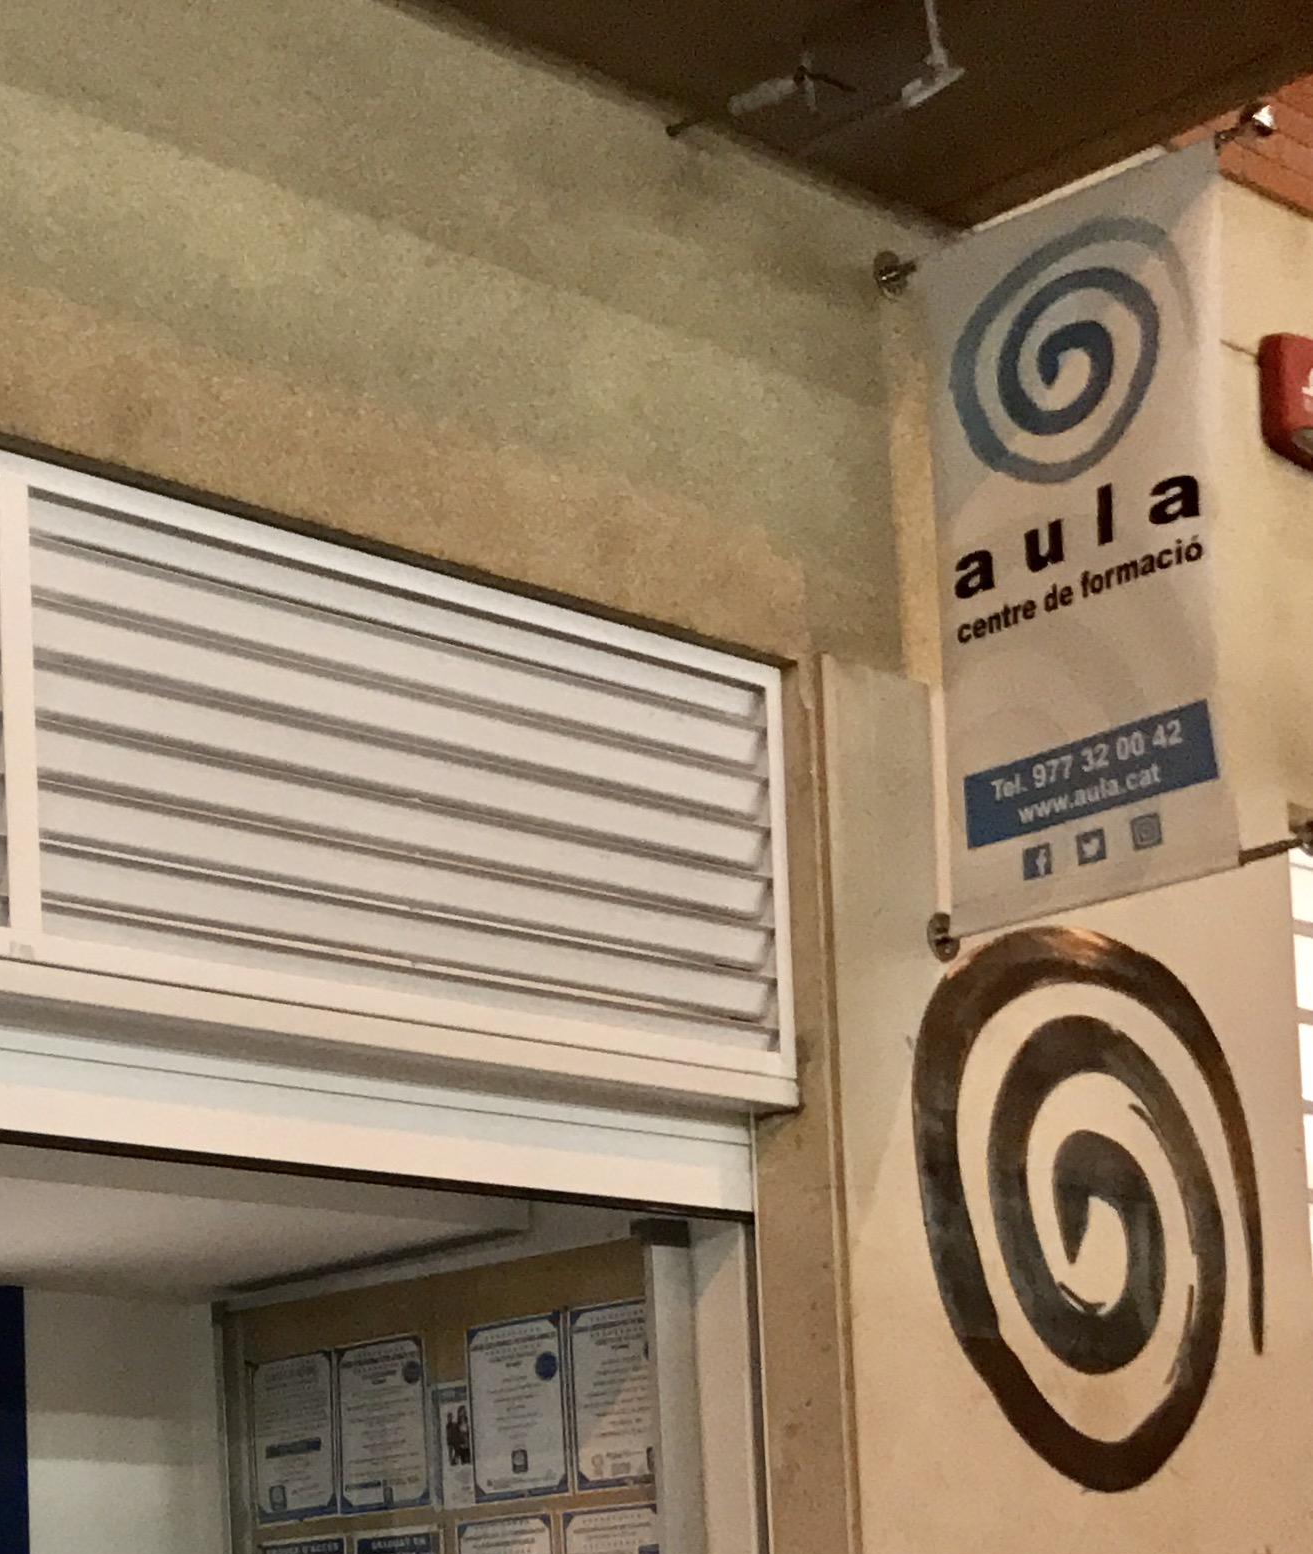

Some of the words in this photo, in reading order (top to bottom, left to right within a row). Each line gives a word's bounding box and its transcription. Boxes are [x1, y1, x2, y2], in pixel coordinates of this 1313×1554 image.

[954, 475, 1201, 599] aula
[957, 600, 1037, 644] centre
[1043, 582, 1074, 613] de
[1080, 535, 1205, 598] formació
[991, 773, 1029, 801] Tel.
[1032, 755, 1074, 790] 977
[1081, 743, 1110, 773] 32
[1116, 731, 1146, 761] 00
[1152, 719, 1184, 747] 42
[1017, 762, 1161, 824] www.aula.cat
